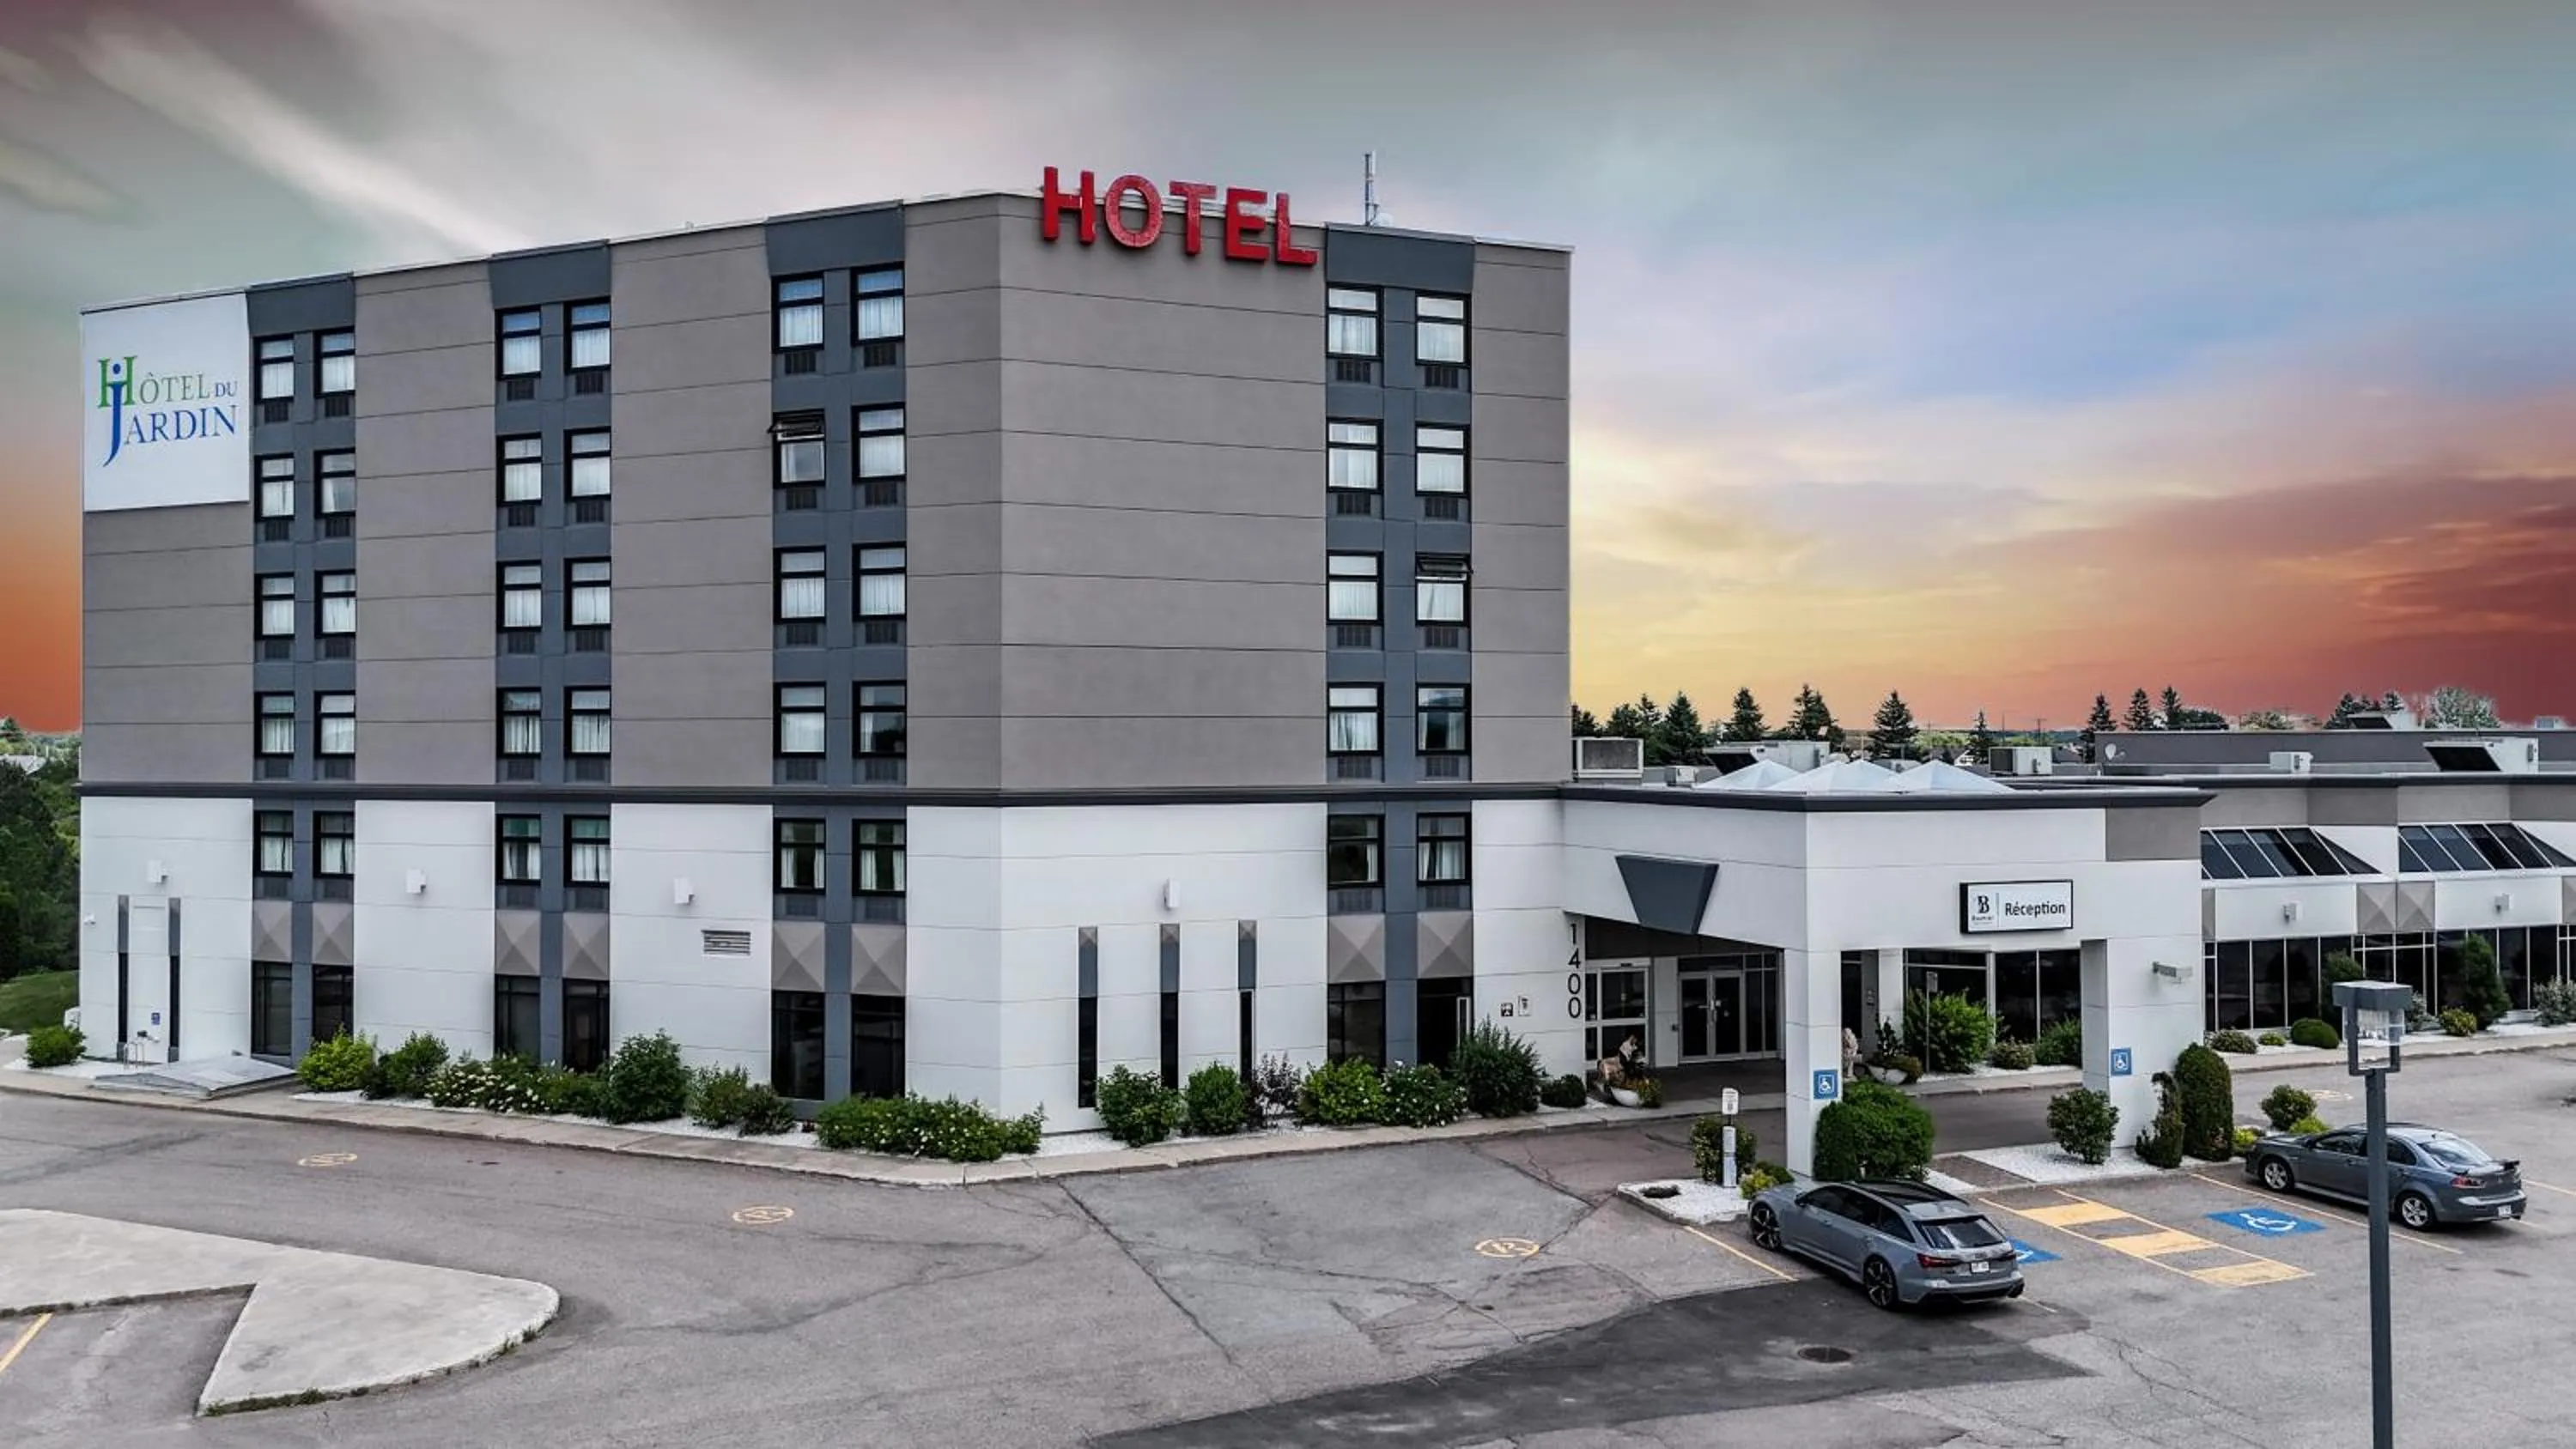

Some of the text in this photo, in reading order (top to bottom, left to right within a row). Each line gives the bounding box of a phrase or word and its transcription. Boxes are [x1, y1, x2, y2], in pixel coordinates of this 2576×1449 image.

[1042, 166, 1319, 265] HOTEL
[97, 355, 238, 409] HÔTEL DU
[102, 383, 238, 468] JARDIN
[2005, 900, 2065, 919] Réception
[1567, 923, 1582, 1019] 1400
